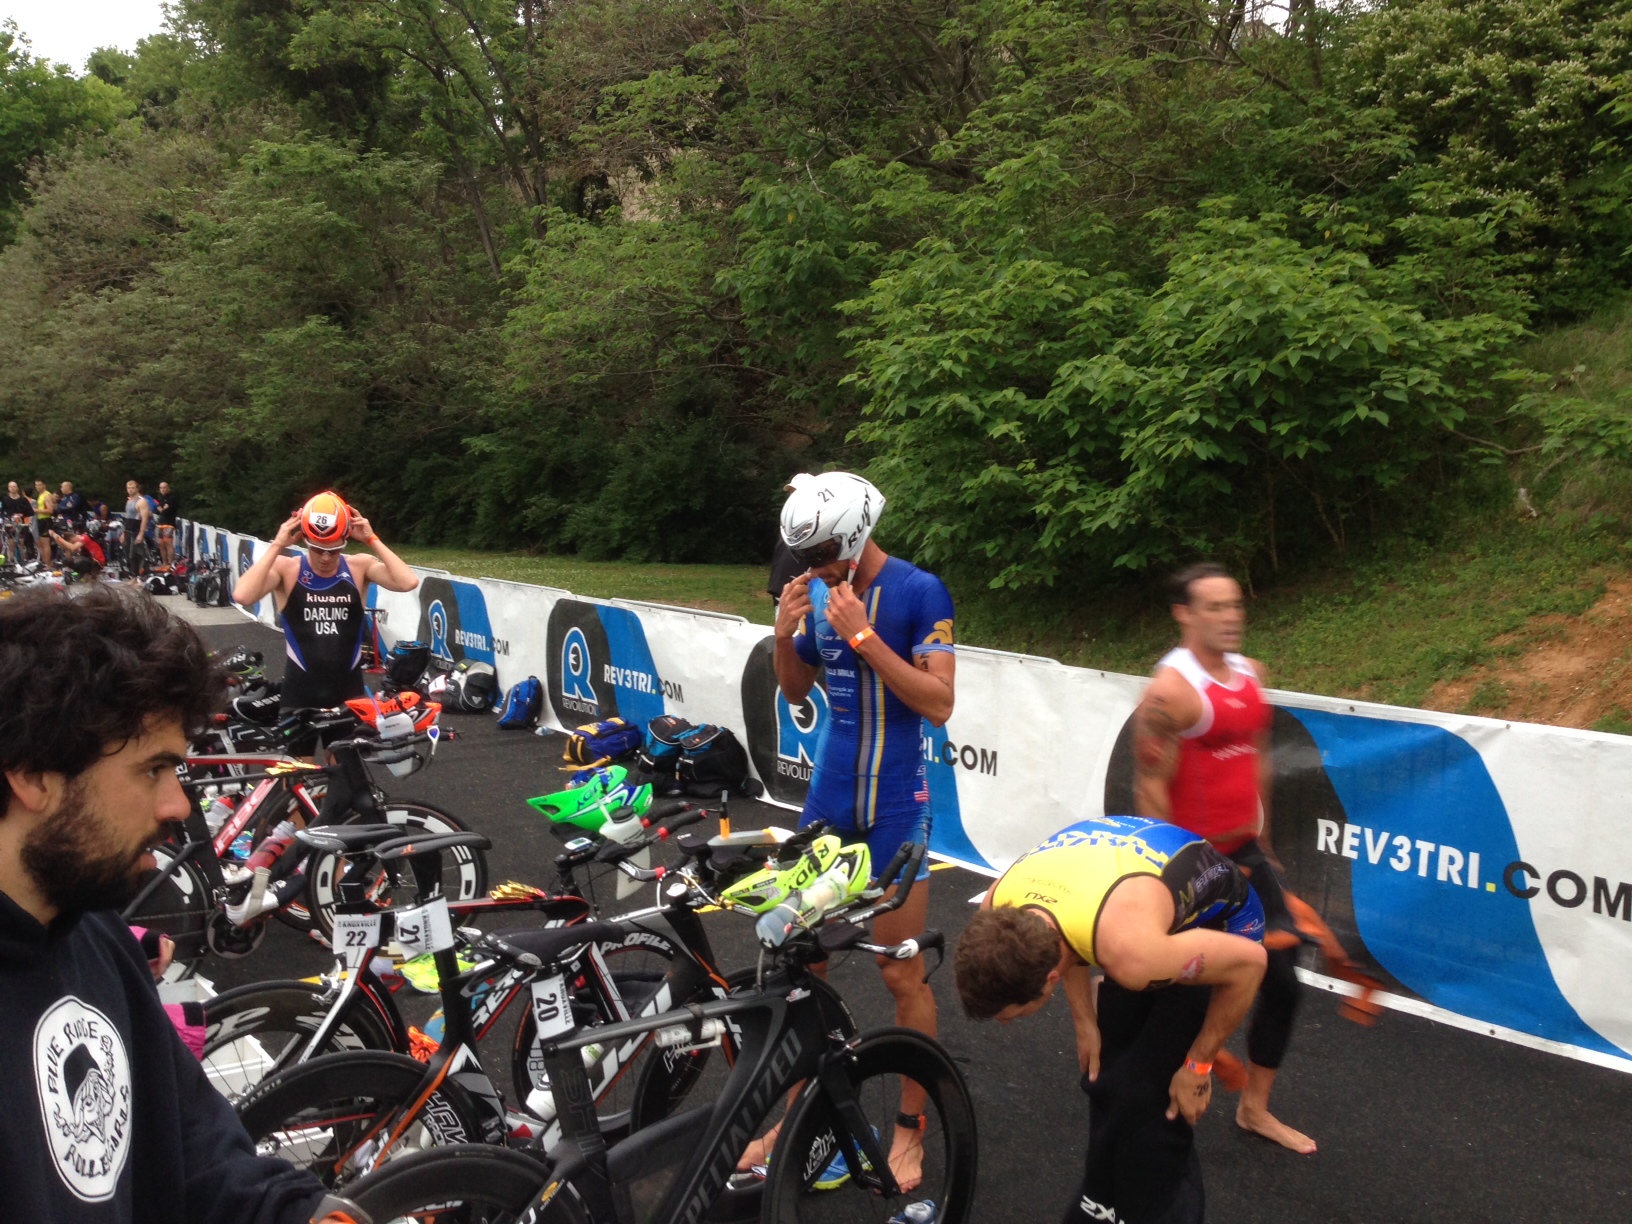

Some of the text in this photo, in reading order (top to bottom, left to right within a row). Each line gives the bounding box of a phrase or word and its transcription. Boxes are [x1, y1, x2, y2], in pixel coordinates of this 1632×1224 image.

[817, 488, 835, 503] 21
[315, 515, 328, 525] 26
[306, 593, 351, 603] kiwami
[303, 607, 349, 621] DARLING
[315, 621, 339, 635] USA
[603, 663, 685, 704] REV3TRI.COM
[1316, 818, 1632, 921] REV3TRI.COM
[345, 930, 367, 947] 22
[399, 924, 421, 945] 21
[535, 992, 559, 1022] 20
[63, 1017, 99, 1045] RIDGE
[680, 1027, 803, 1224] PECIALIZED
